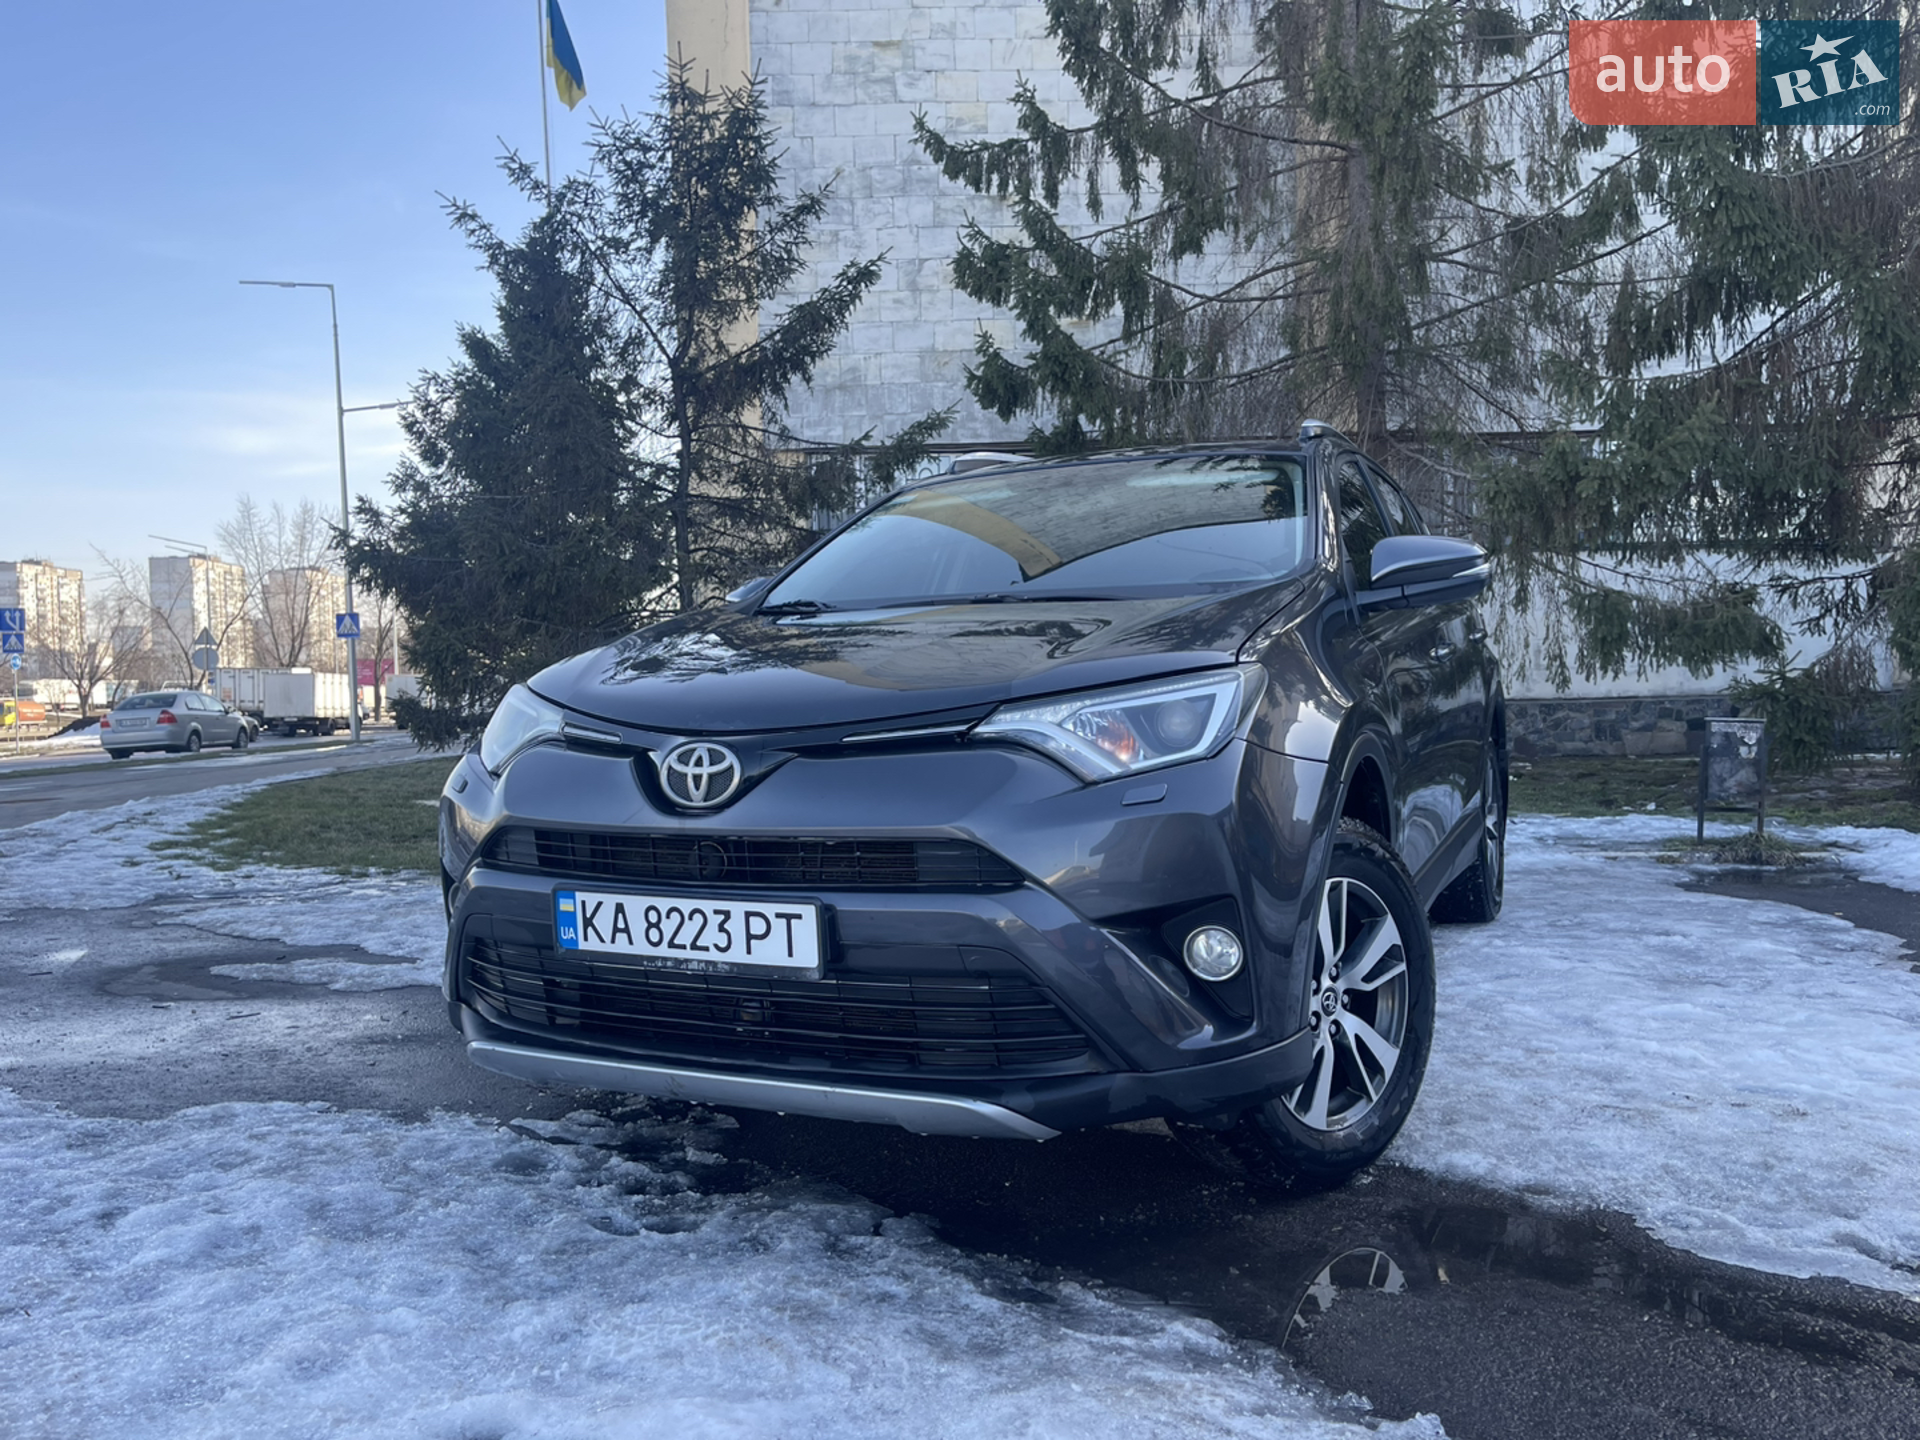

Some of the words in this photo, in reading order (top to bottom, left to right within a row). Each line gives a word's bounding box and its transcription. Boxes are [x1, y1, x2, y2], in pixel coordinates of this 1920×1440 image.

[560, 926, 576, 940] UA
[581, 899, 634, 946] KA
[643, 904, 732, 953] 8223
[744, 910, 803, 958] PT
